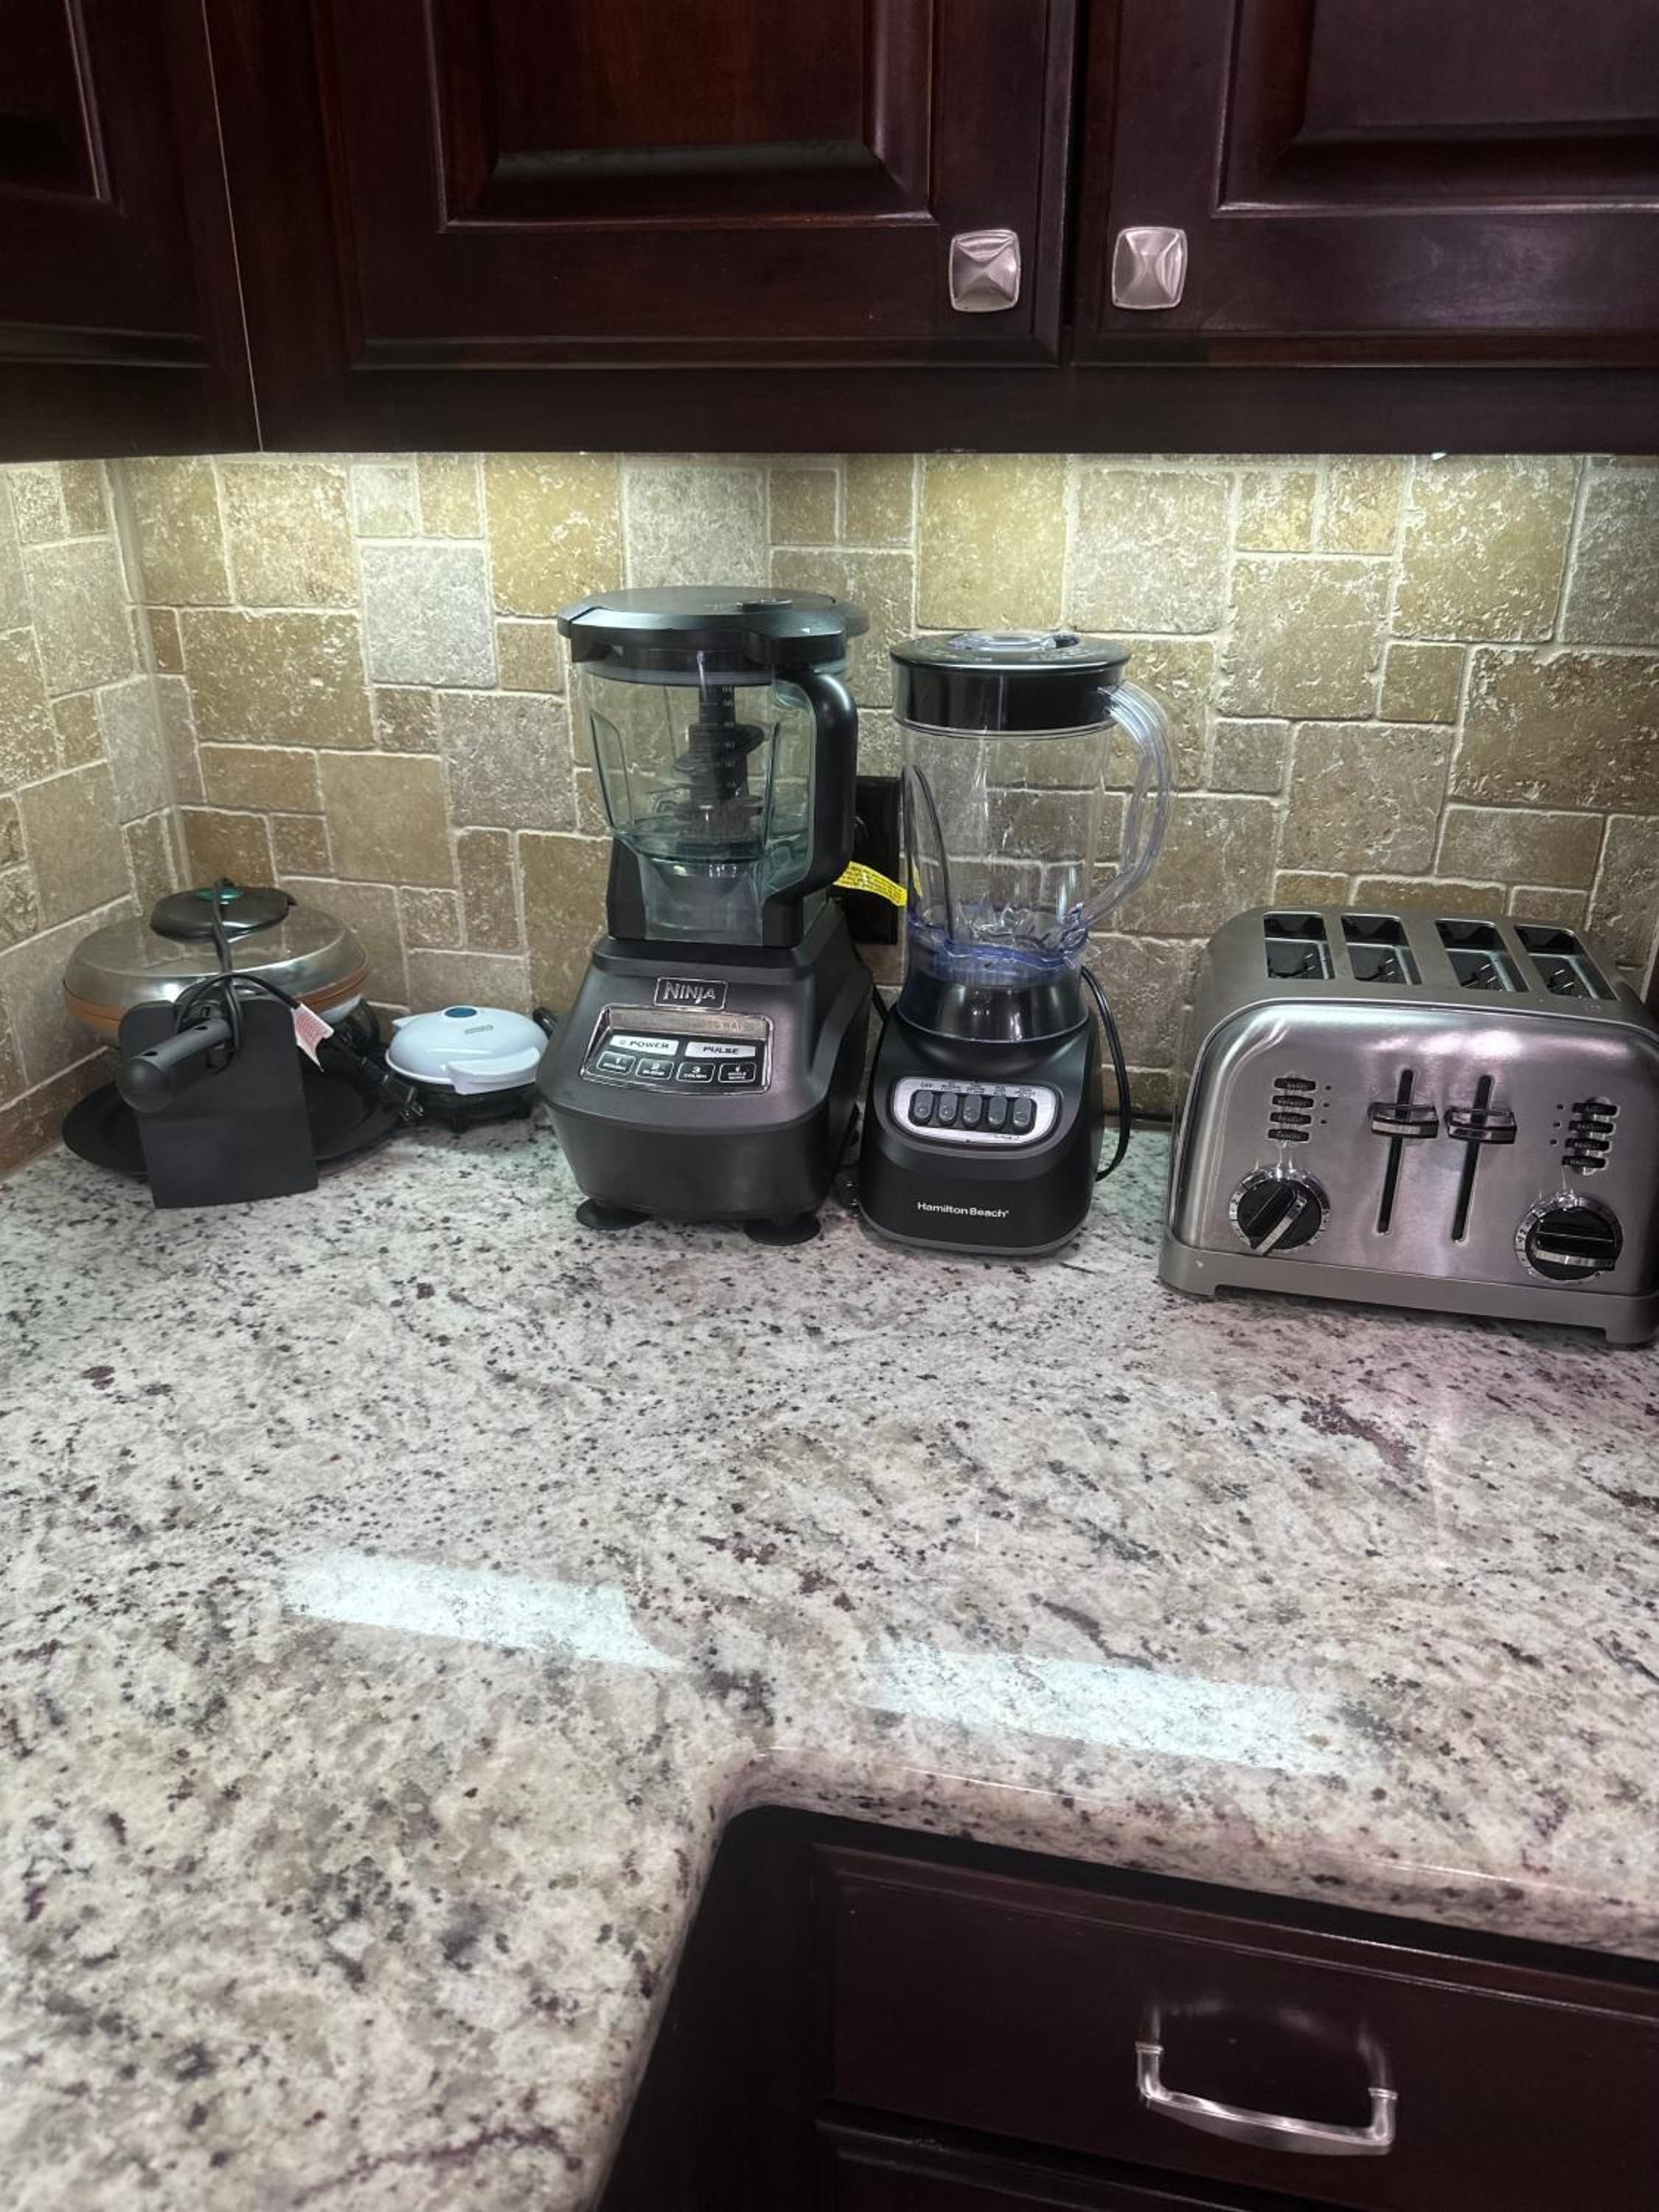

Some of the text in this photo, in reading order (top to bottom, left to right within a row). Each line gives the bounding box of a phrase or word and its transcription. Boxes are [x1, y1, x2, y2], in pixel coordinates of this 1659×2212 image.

[663, 981, 716, 1005] NINJA
[629, 1040, 670, 1049] POWER
[703, 1046, 740, 1054] PULSE
[692, 1065, 701, 1074] 3
[917, 1201, 968, 1215] Hamilton
